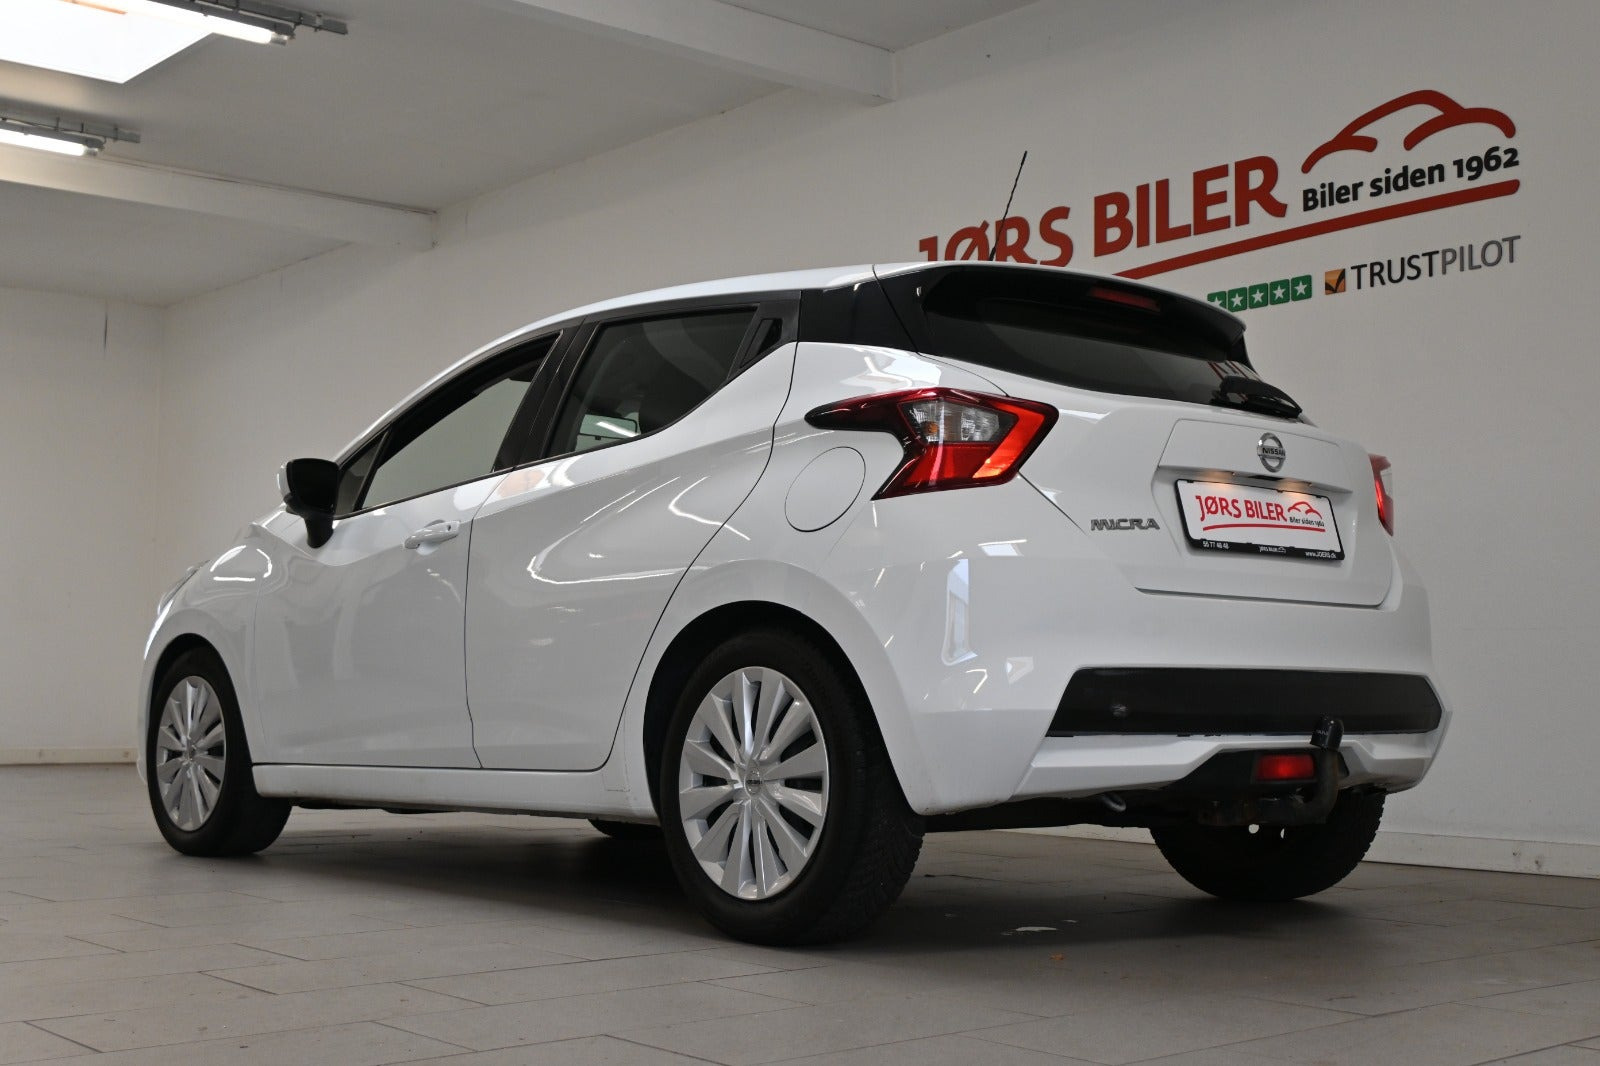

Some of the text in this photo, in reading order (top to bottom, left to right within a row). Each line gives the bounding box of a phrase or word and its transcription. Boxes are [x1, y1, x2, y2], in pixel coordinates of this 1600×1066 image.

[1302, 146, 1520, 212] Biler siden 1962
[1094, 156, 1288, 258] BILER
[1351, 235, 1521, 290] TRUSTPILOT
[1262, 447, 1286, 457] NISSAN
[1090, 518, 1160, 531] MICRA
[1195, 495, 1288, 522] JØRS BILER
